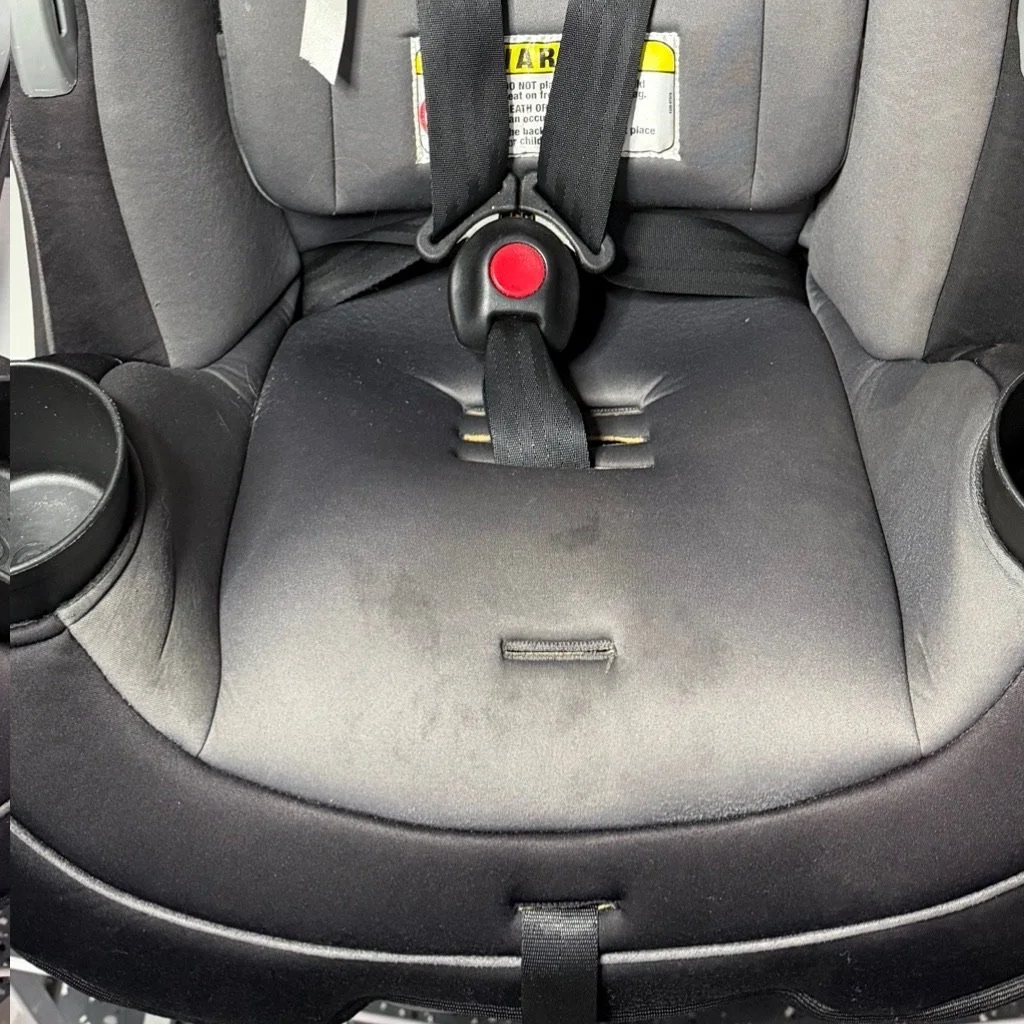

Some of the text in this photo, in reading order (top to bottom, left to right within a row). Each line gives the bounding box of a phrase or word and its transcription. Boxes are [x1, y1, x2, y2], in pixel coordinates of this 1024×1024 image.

[518, 81, 537, 90] NOT
[539, 80, 552, 91] pla
[508, 91, 523, 100] eat
[509, 104, 533, 113] EATH
[523, 115, 545, 123] occu
[508, 128, 520, 136] he
[630, 126, 656, 136] place
